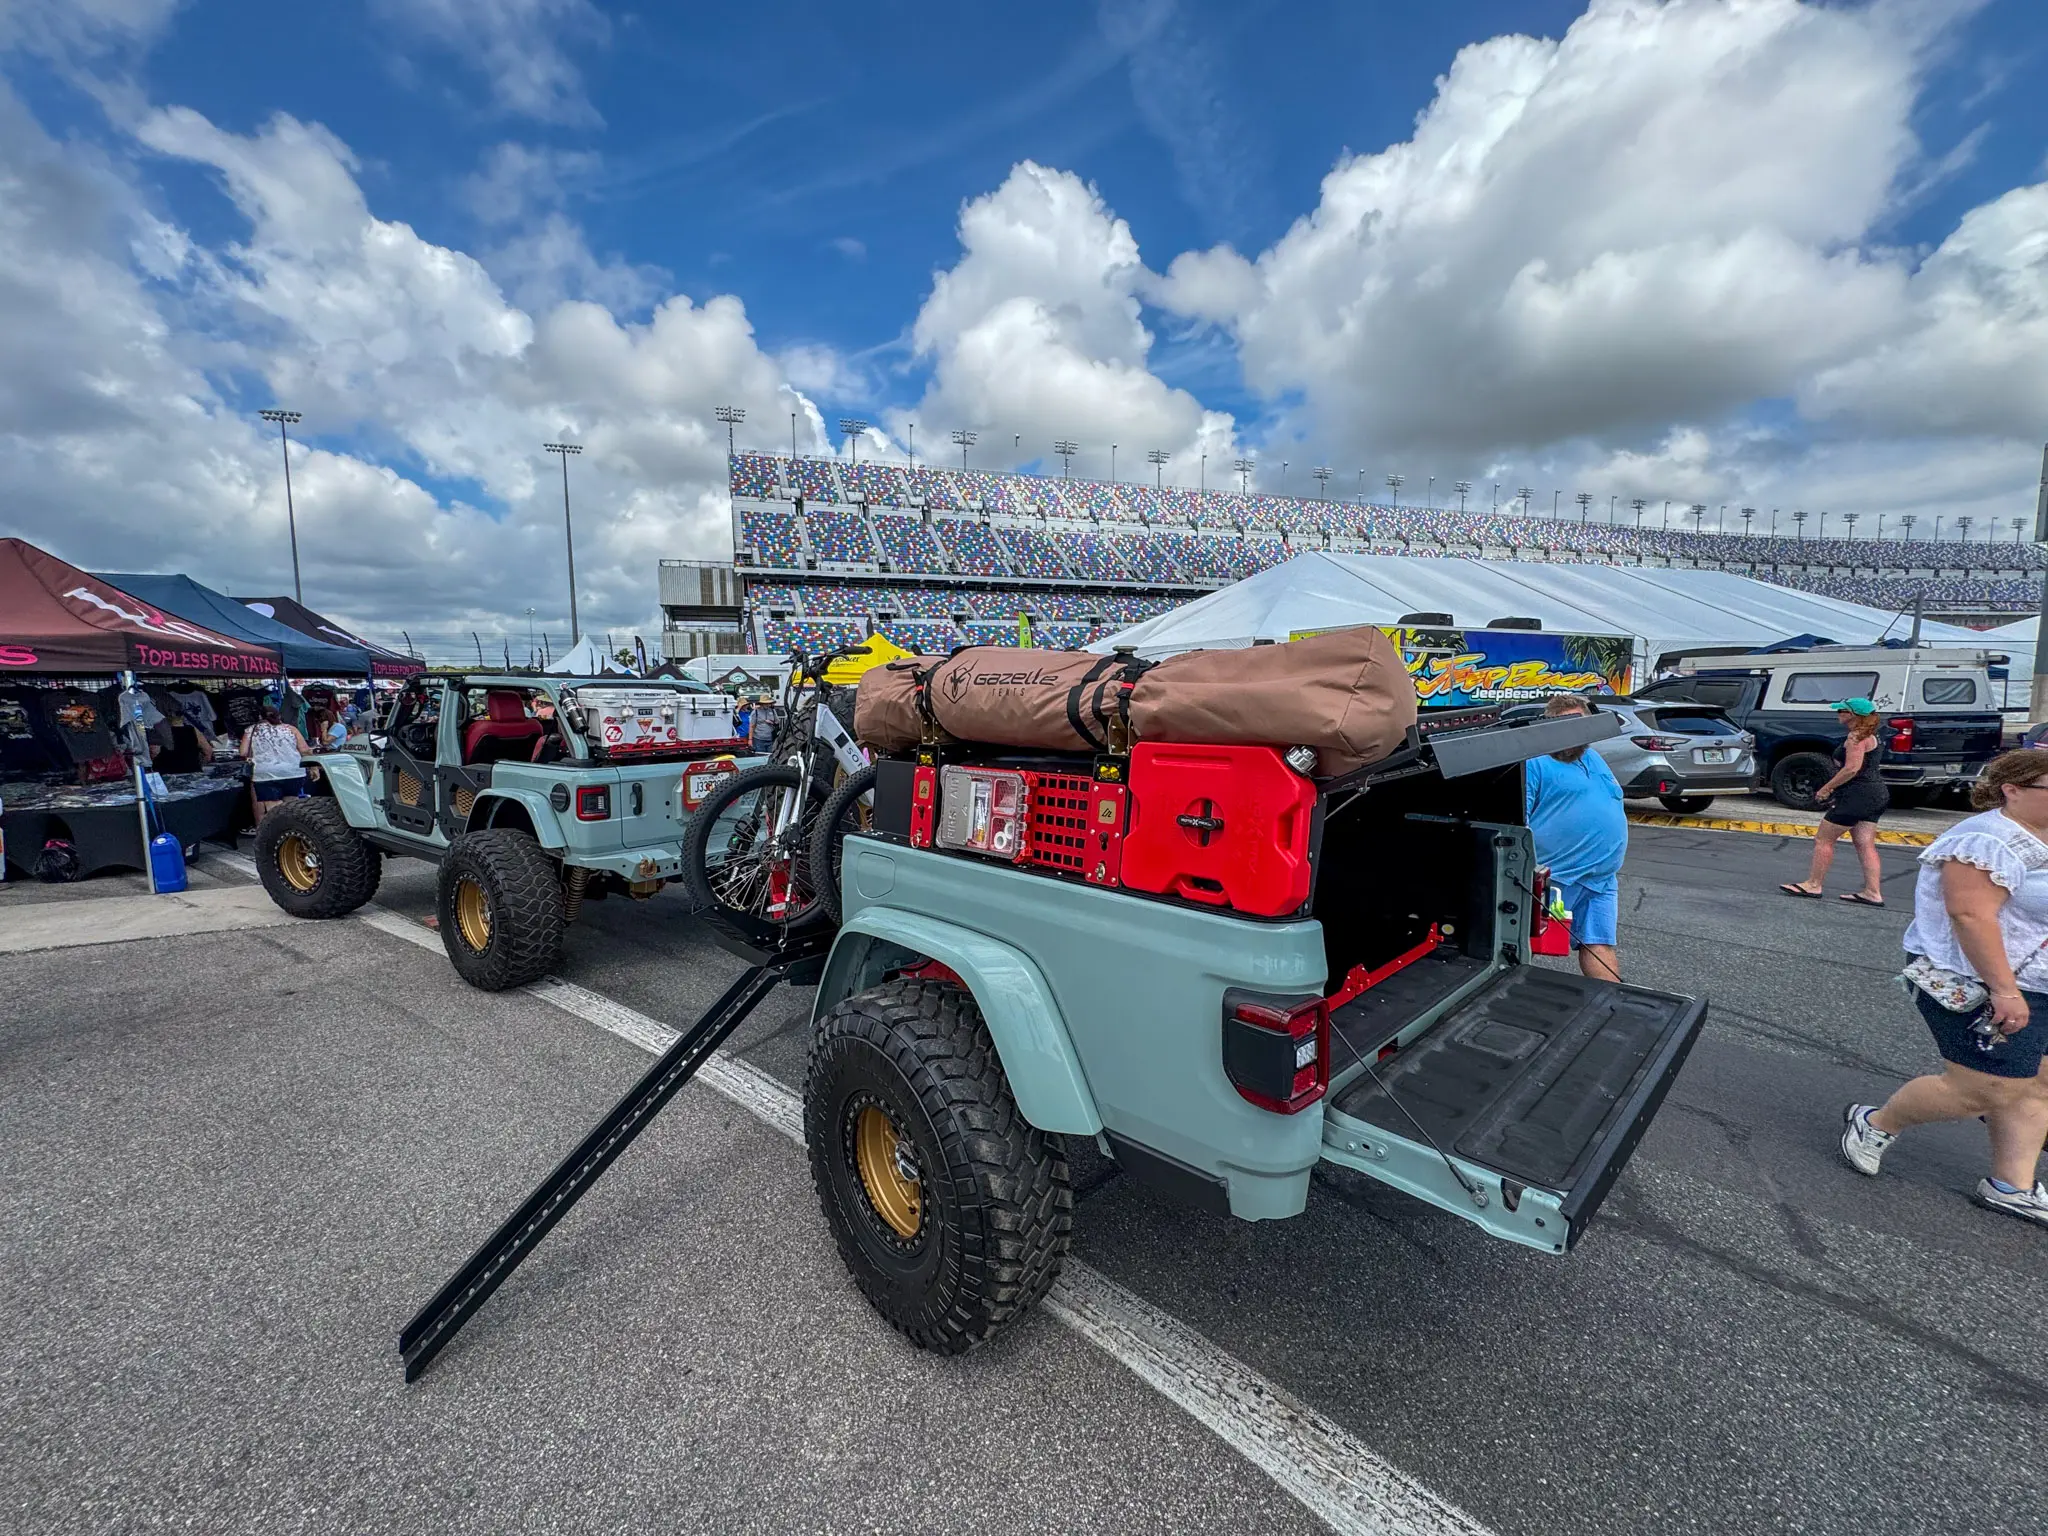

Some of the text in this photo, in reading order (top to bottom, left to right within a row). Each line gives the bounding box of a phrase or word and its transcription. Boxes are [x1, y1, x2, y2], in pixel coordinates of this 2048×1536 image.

[135, 643, 280, 674] TOPLESS FOR TATAS
[372, 661, 400, 675] TOPLESS
[992, 687, 1026, 697] TENTS
